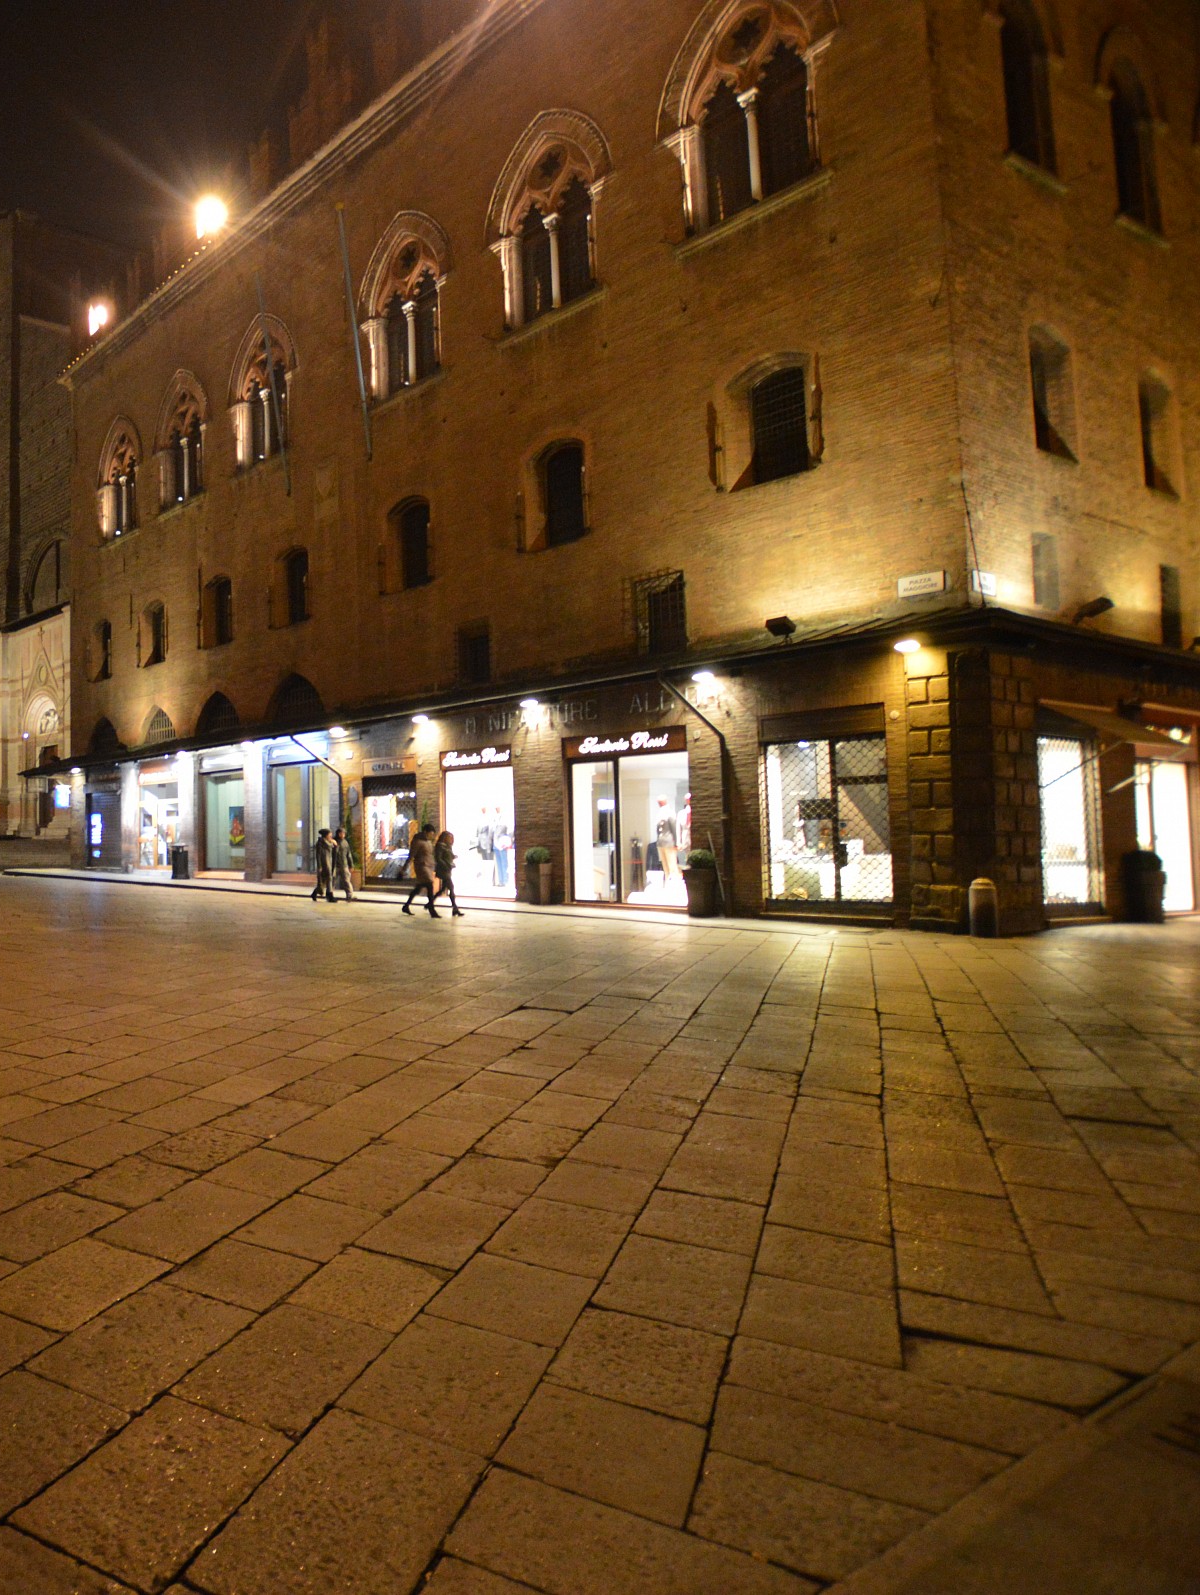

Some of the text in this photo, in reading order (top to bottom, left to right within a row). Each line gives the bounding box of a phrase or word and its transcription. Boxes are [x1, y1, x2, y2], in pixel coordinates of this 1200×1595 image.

[909, 577, 932, 585] PIAZZA
[903, 583, 938, 592] MAGGIORE
[579, 731, 669, 755] Sartoria Rossi
[442, 751, 481, 767] Sartoria
